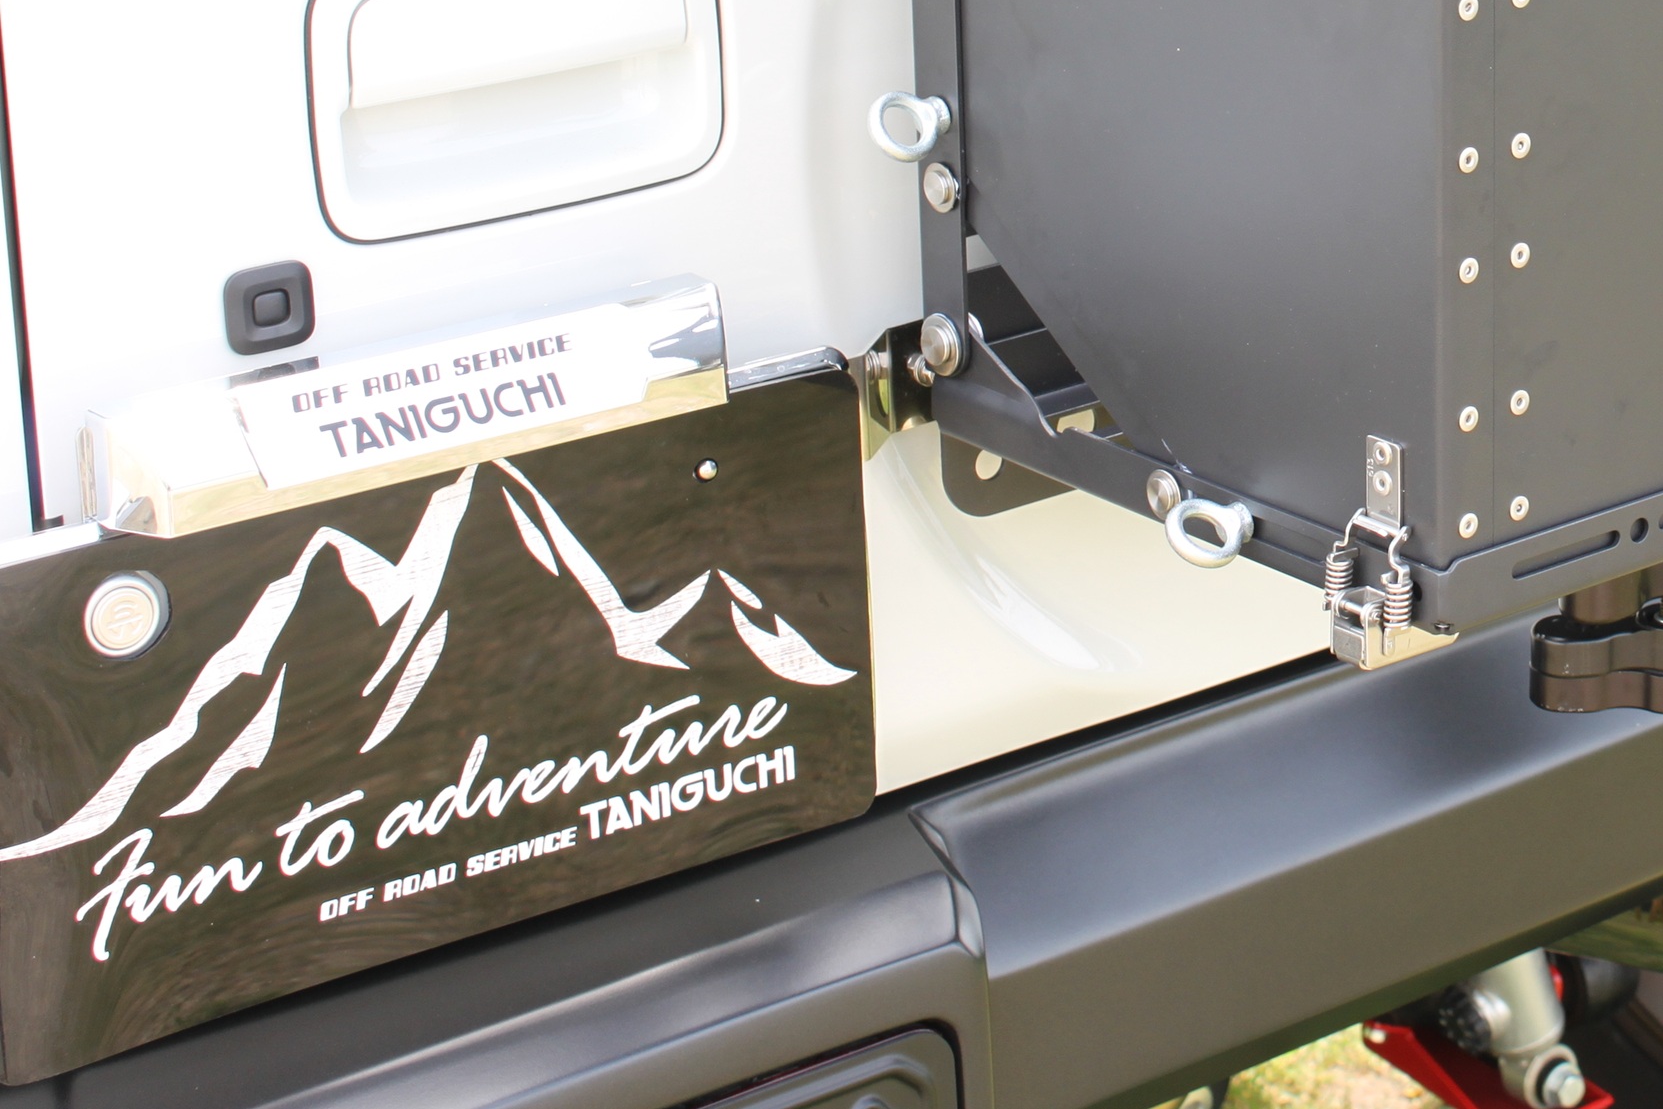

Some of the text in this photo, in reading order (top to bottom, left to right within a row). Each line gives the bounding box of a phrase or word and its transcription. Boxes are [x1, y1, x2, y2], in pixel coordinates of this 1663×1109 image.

[291, 333, 572, 413] OFF ROAD SERVICE
[319, 372, 567, 458] TANIGUCHI
[75, 694, 789, 962] Fun to adventure
[318, 745, 797, 923] OFF ROAD SERVICE TANIGUCHI
